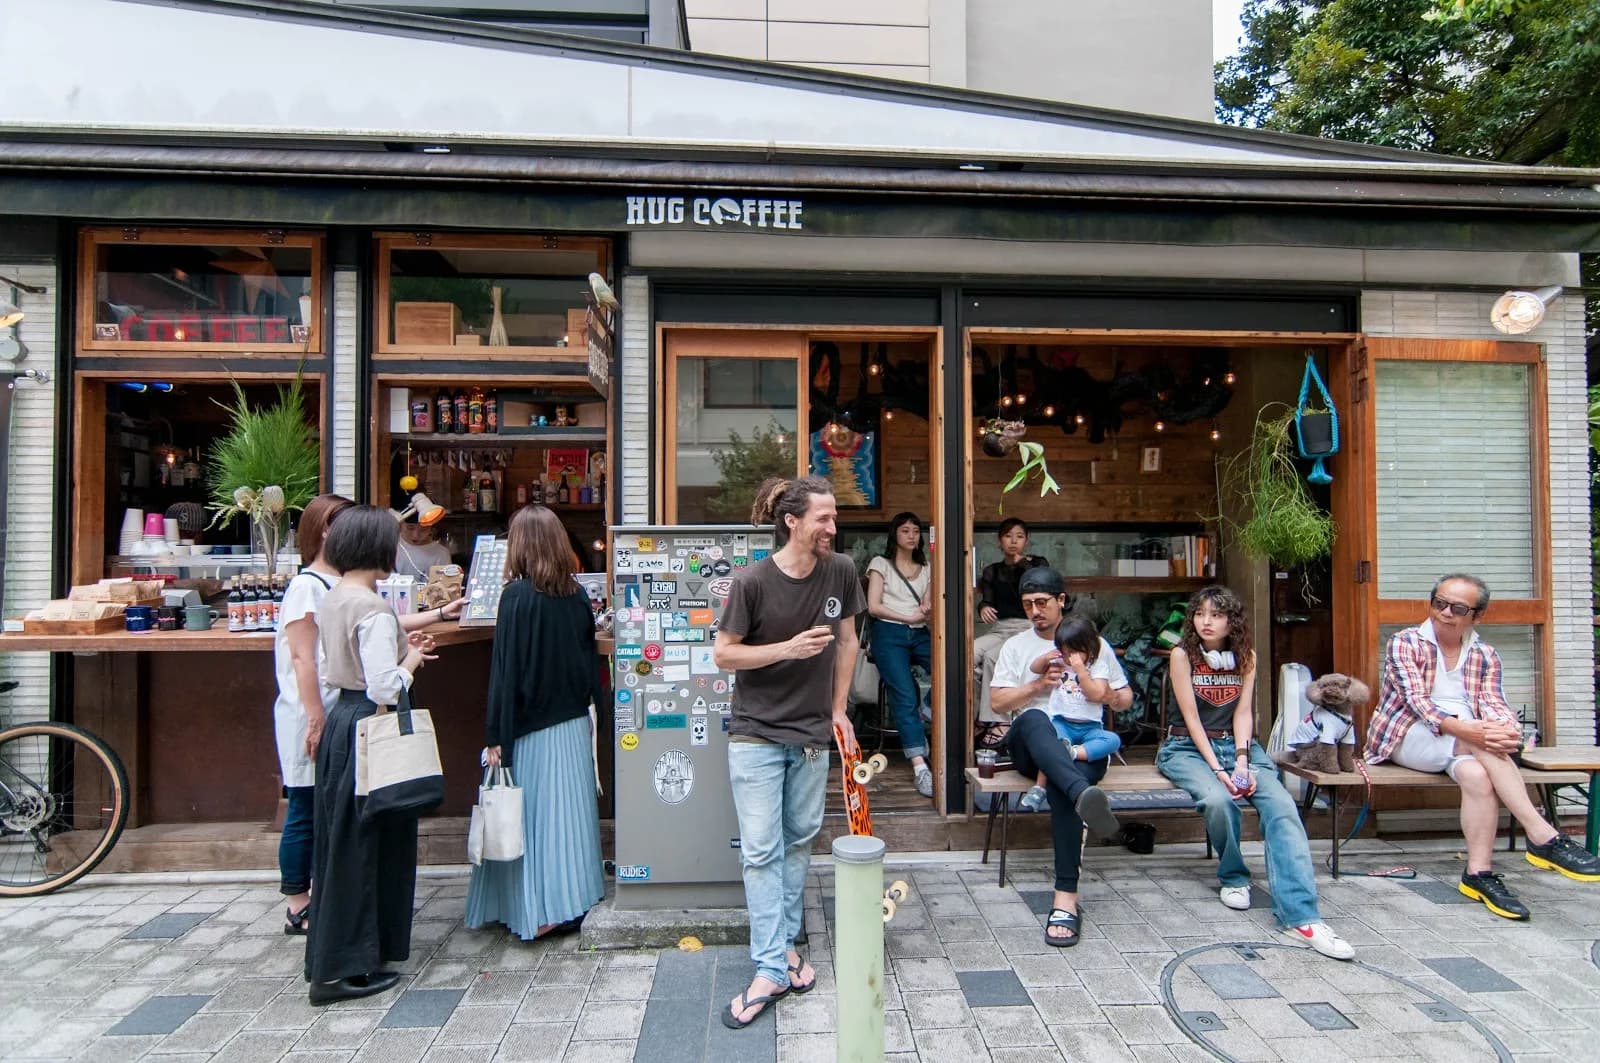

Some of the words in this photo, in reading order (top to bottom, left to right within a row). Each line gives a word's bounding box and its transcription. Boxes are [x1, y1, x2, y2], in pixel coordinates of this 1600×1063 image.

[626, 196, 685, 225] HUG
[693, 198, 803, 229] COFFEE
[1203, 687, 1236, 701] CYCLES
[620, 866, 647, 877] RUDIES
